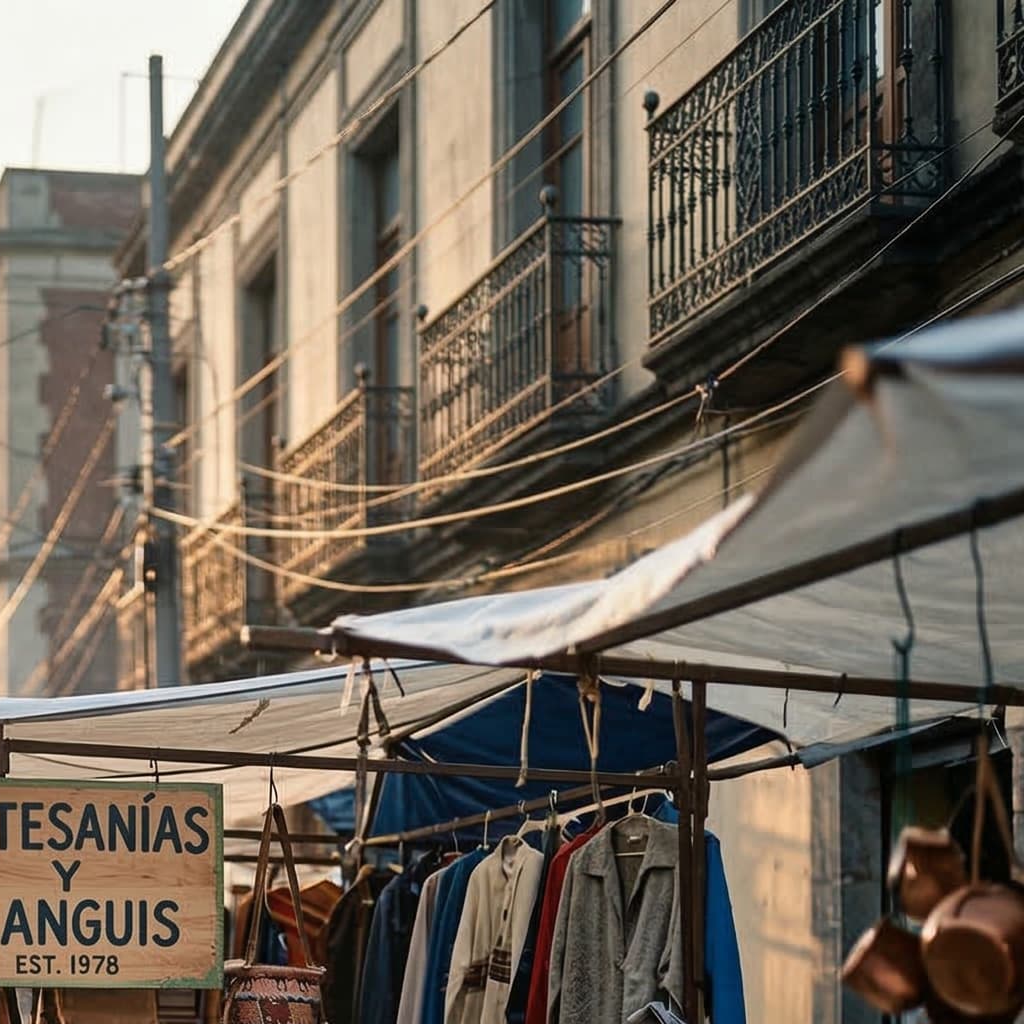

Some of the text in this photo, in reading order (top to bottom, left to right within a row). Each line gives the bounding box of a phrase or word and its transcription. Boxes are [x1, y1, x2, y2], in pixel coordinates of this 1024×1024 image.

[51, 860, 81, 892] Y
[15, 954, 120, 976] EST. 1978
